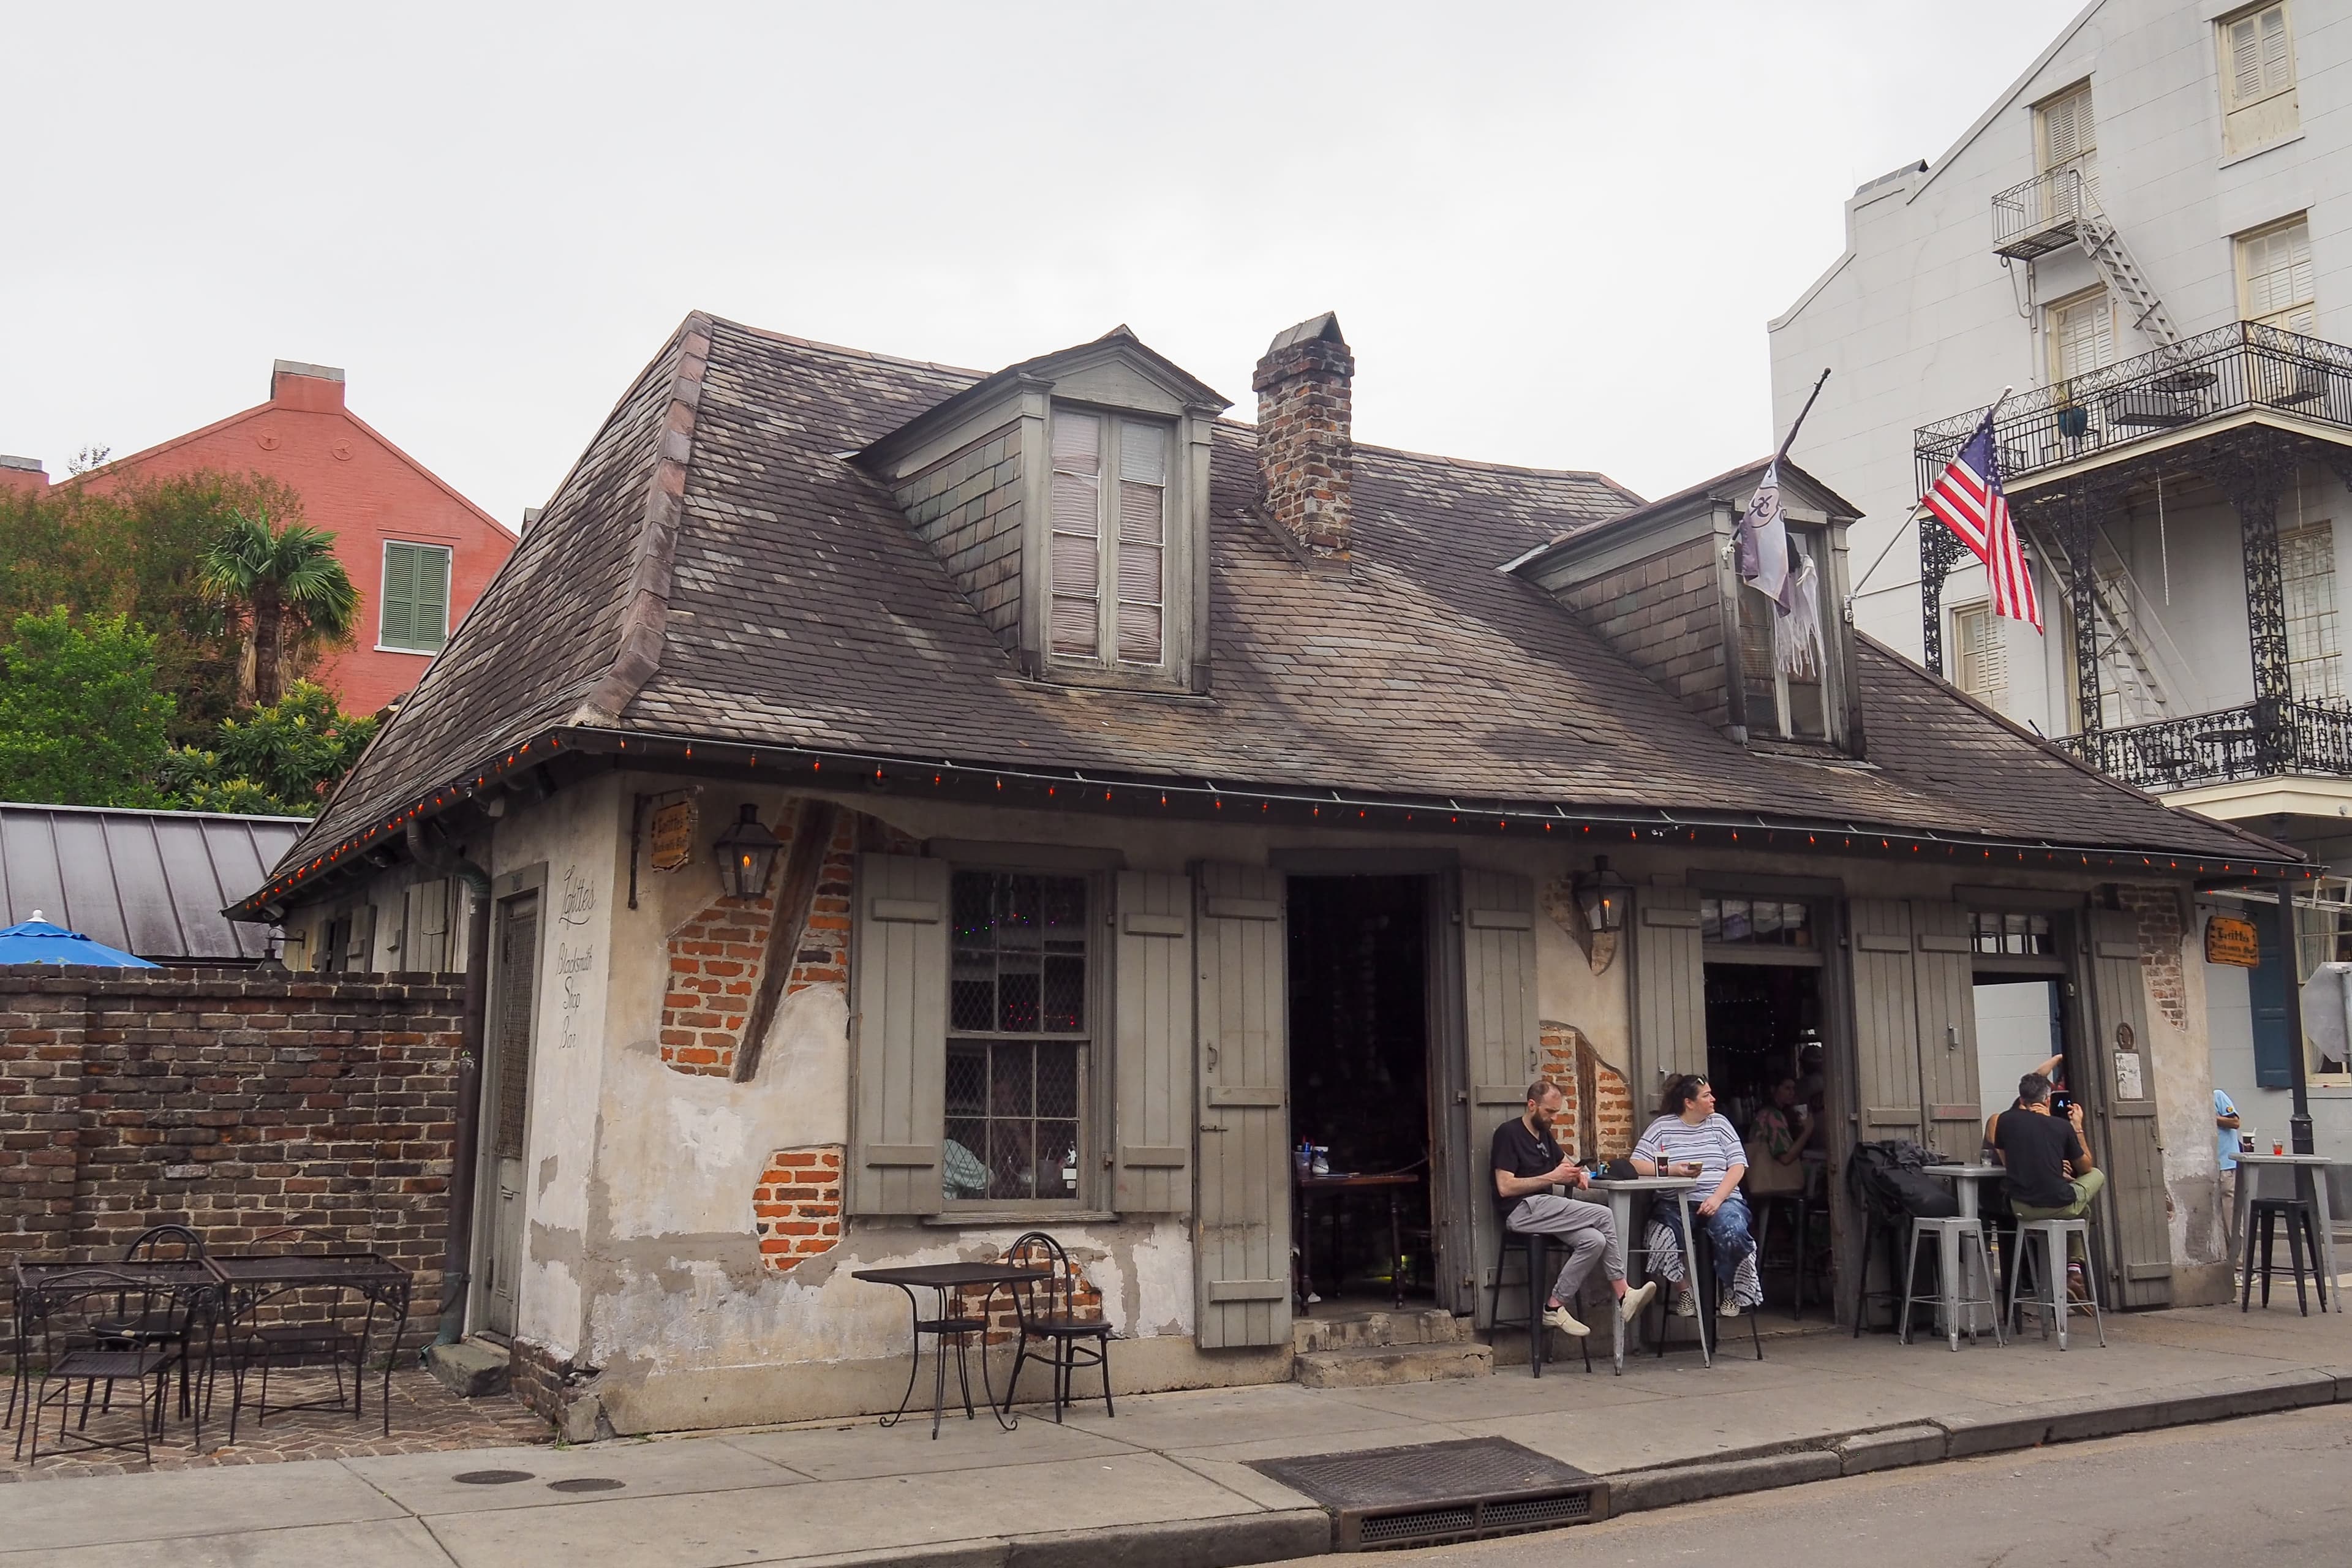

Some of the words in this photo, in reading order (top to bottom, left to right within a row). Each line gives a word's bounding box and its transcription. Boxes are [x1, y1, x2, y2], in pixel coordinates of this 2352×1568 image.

[558, 864, 597, 930] Lafitte's
[556, 942, 593, 976] Blacksmith
[563, 976, 581, 1014] Shop
[559, 1016, 576, 1049] Bar
